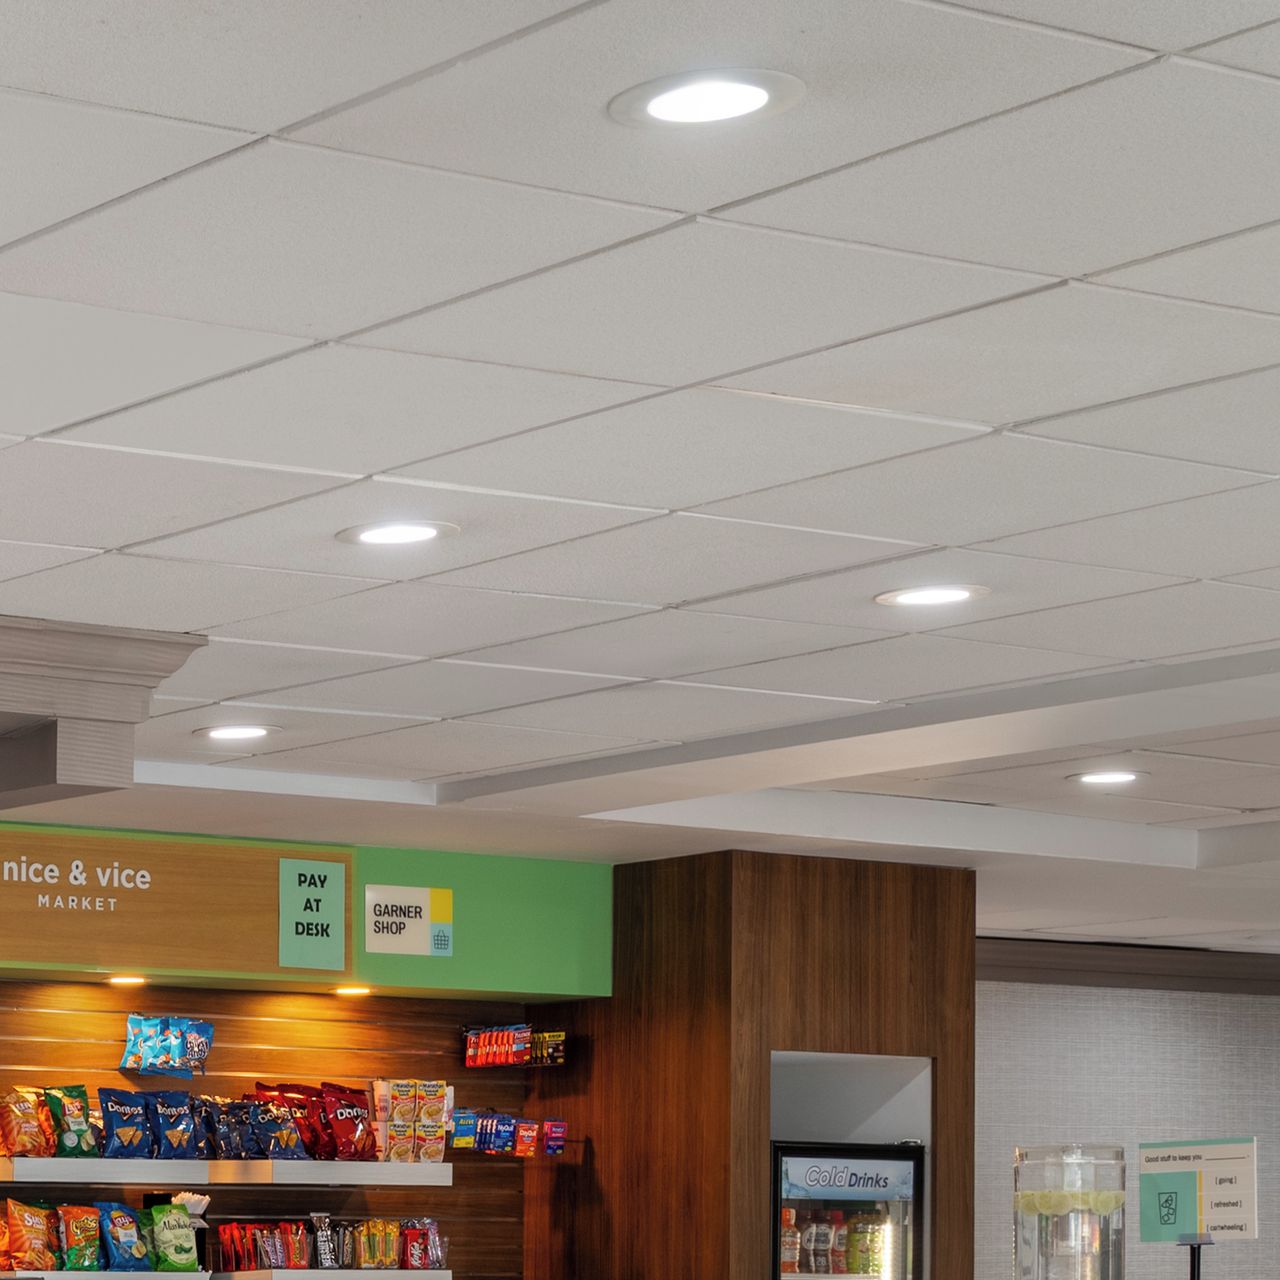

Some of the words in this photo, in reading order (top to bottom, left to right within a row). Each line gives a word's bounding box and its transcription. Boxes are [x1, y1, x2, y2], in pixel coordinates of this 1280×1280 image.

[3, 855, 60, 885] nice
[68, 859, 88, 886] &
[96, 862, 152, 889] vice
[297, 872, 328, 889] PAY
[37, 893, 118, 912] MARKET
[302, 897, 322, 914] AT
[372, 903, 423, 920] GARNER
[294, 921, 331, 938] DESK
[372, 919, 406, 936] SHOP
[107, 1101, 144, 1115] Doritos
[156, 1103, 190, 1116] Doritos
[335, 1106, 369, 1121] Doritos
[805, 1165, 849, 1188] Cold
[848, 1172, 889, 1189] Drinks
